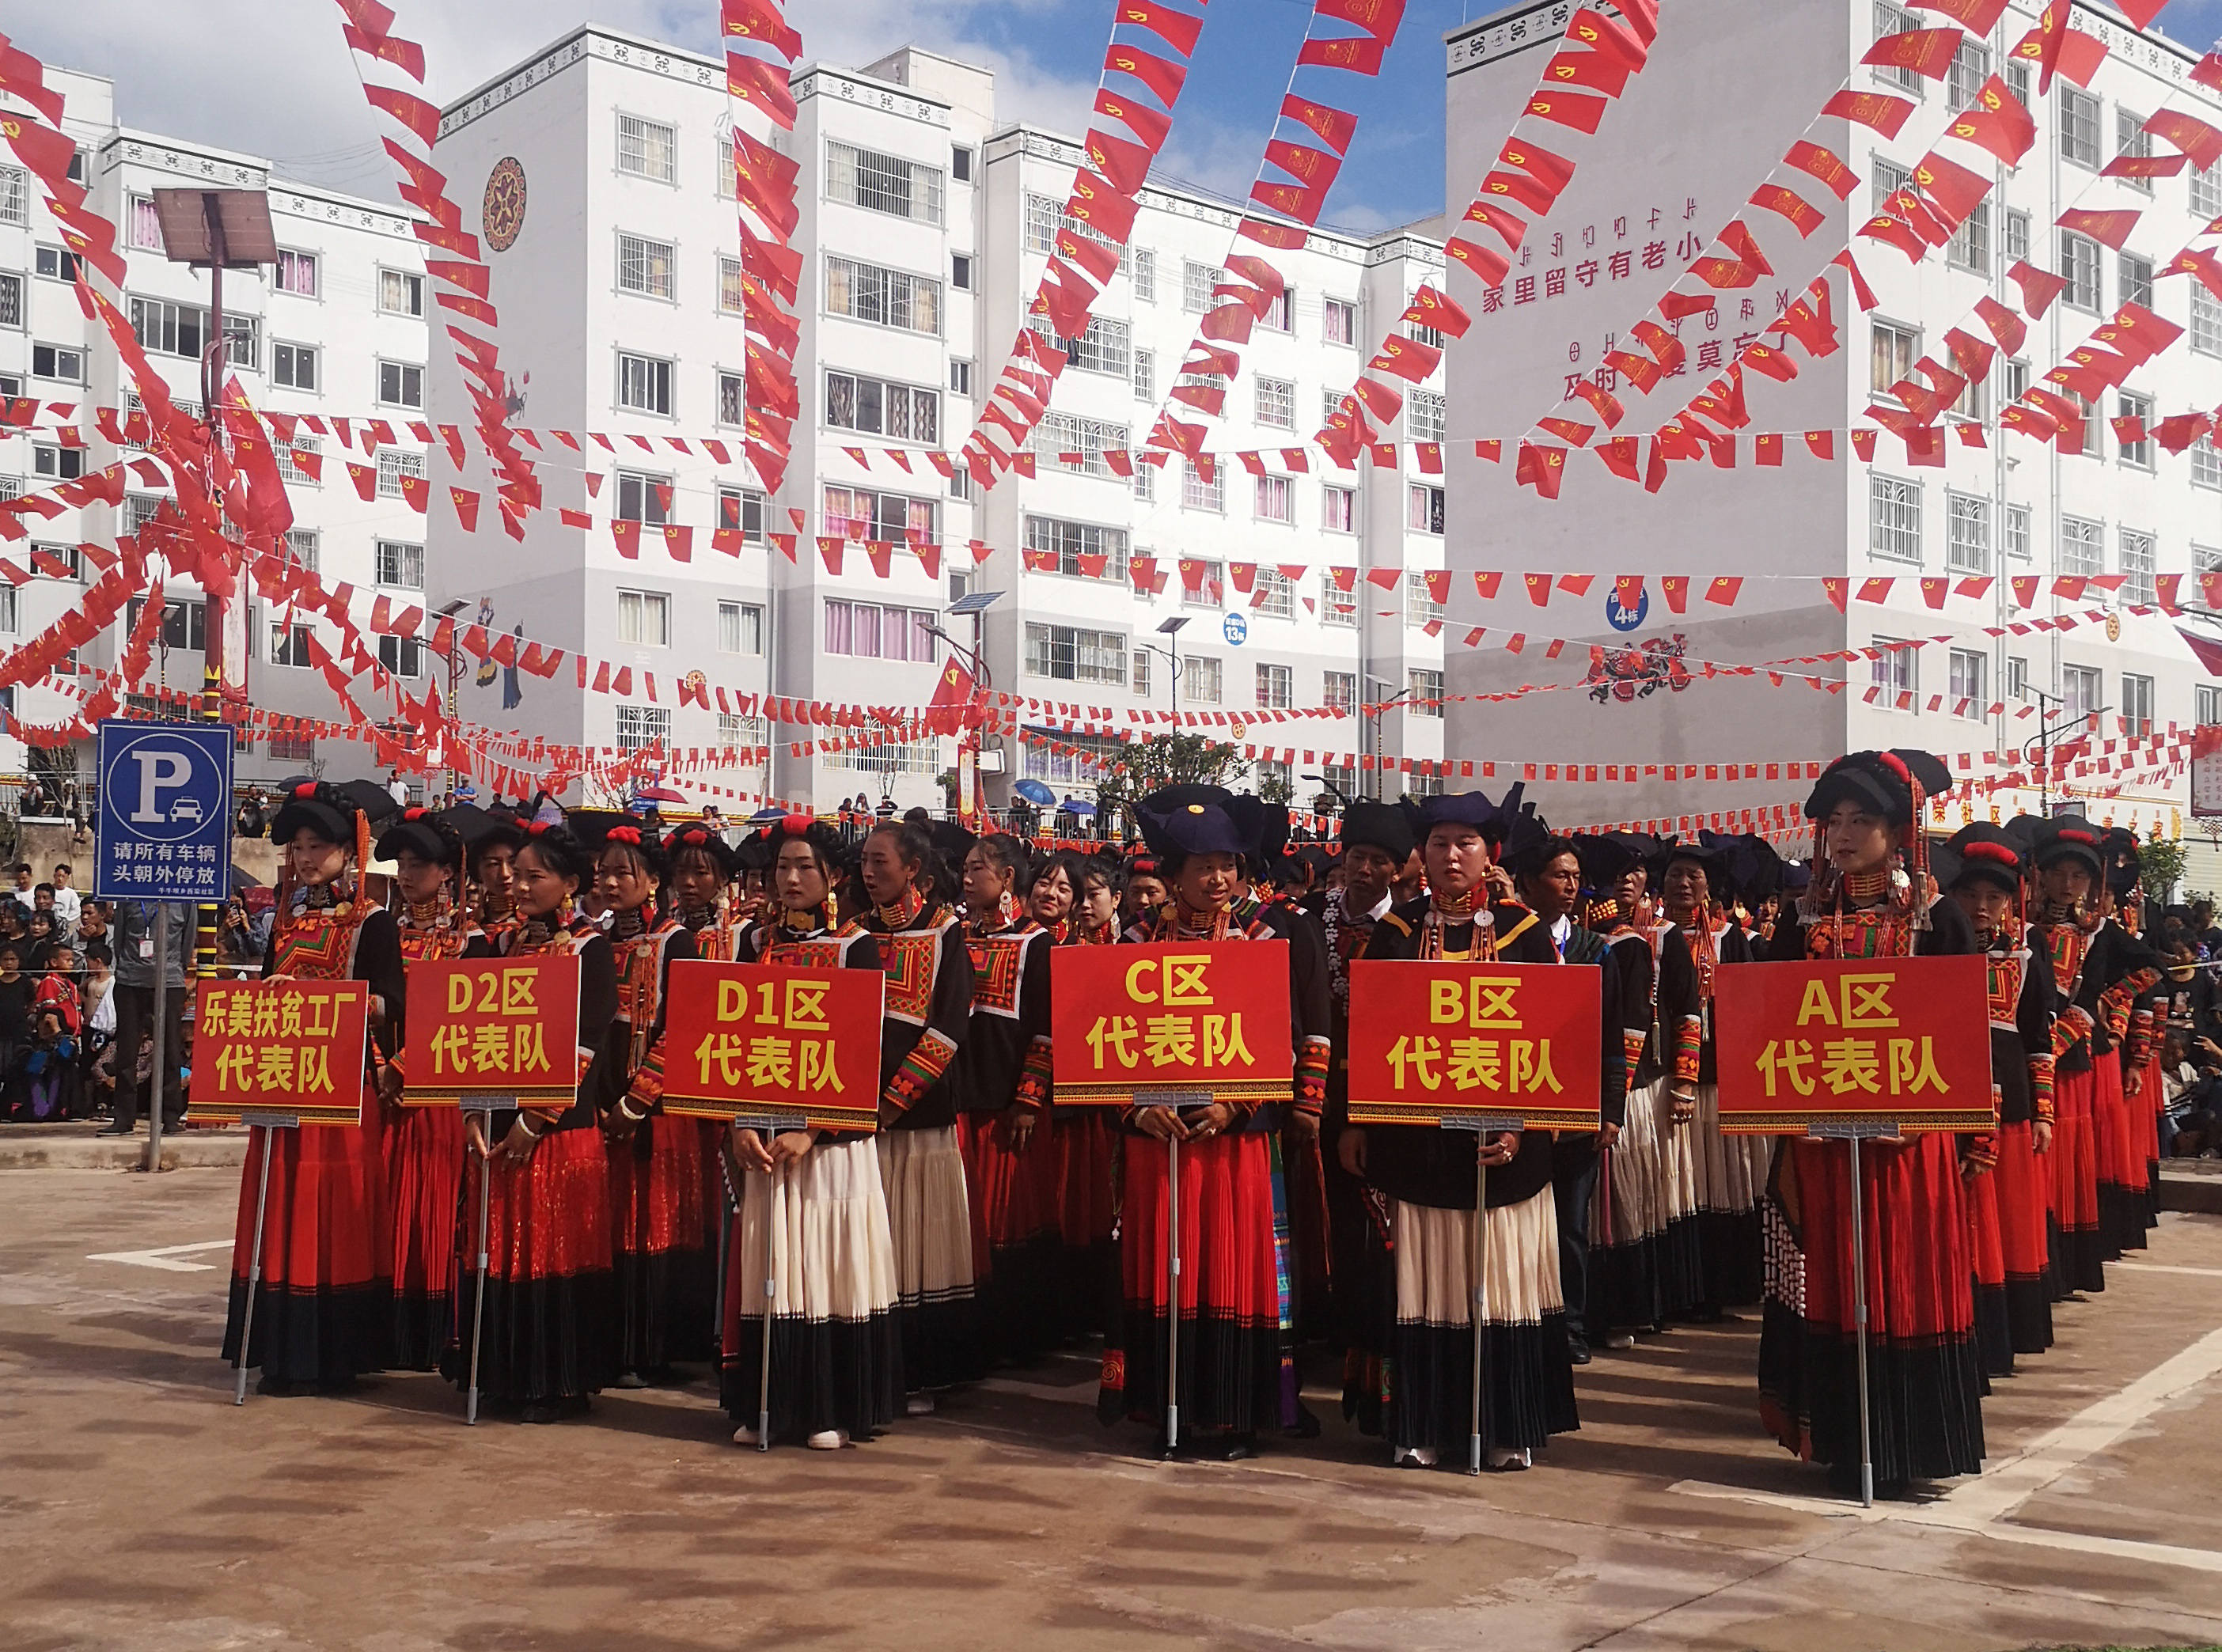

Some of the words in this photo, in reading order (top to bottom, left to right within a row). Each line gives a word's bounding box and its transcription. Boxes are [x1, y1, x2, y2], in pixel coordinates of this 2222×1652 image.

[1482, 231, 1703, 314] 家里留守有老小
[131, 750, 192, 823] P
[112, 864, 215, 885] 头朝外停放
[113, 842, 217, 862] 请所有车辆
[448, 967, 539, 1015] D2区
[717, 979, 830, 1031] D1区
[1125, 954, 1214, 1006] C区
[1430, 976, 1522, 1029] B区
[1796, 972, 1899, 1029] A区
[203, 989, 356, 1038] 乐美扶贫工厂
[430, 1022, 552, 1074] 代表队
[694, 1032, 845, 1093] 代表队
[1085, 1012, 1256, 1069] 代表队
[1386, 1035, 1564, 1095] 代表队
[1755, 1036, 1951, 1097] 代表队
[215, 1044, 335, 1094] 代表队
